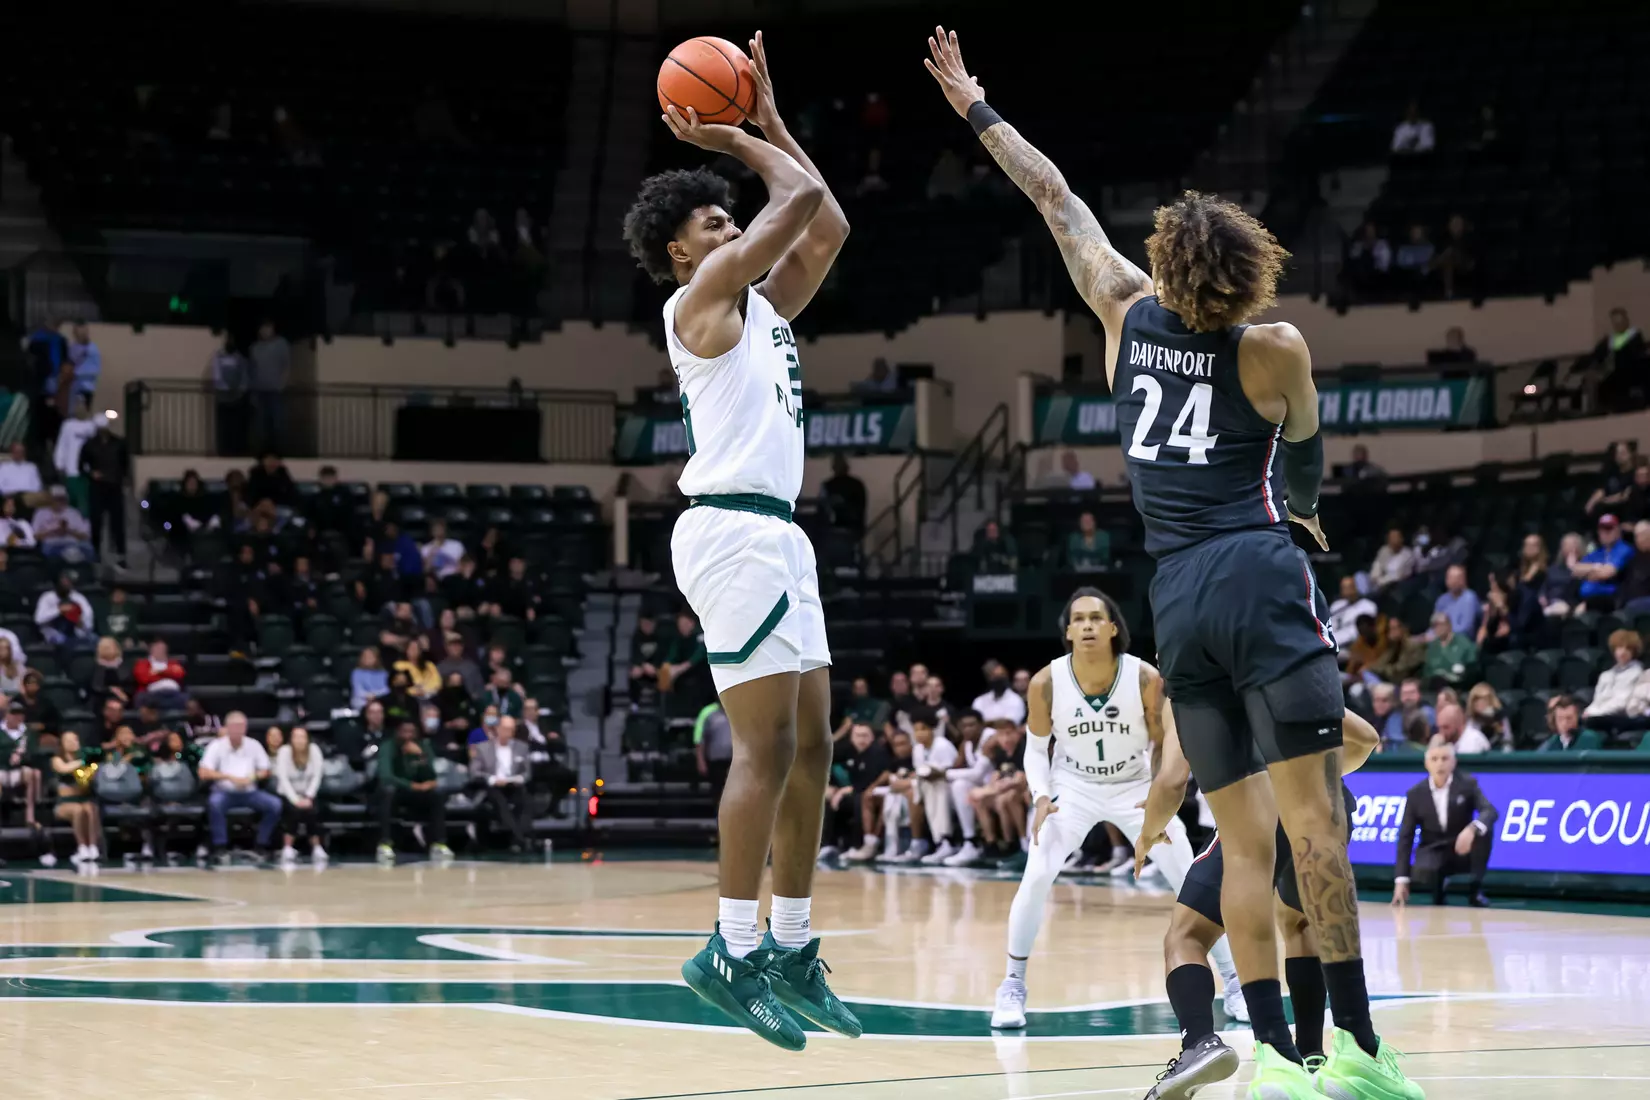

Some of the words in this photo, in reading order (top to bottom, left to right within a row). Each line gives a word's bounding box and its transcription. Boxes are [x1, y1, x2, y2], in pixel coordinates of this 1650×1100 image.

[1130, 340, 1215, 377] DAVENPORT
[1128, 374, 1219, 464] 24
[1347, 387, 1452, 423] FLORIDA
[808, 412, 882, 446] BULLS
[1068, 721, 1130, 737] SOUTH
[1096, 738, 1105, 761] 1
[1351, 795, 1407, 827] OFFI
[1501, 800, 1555, 842] BE
[1559, 800, 1650, 845] COU
